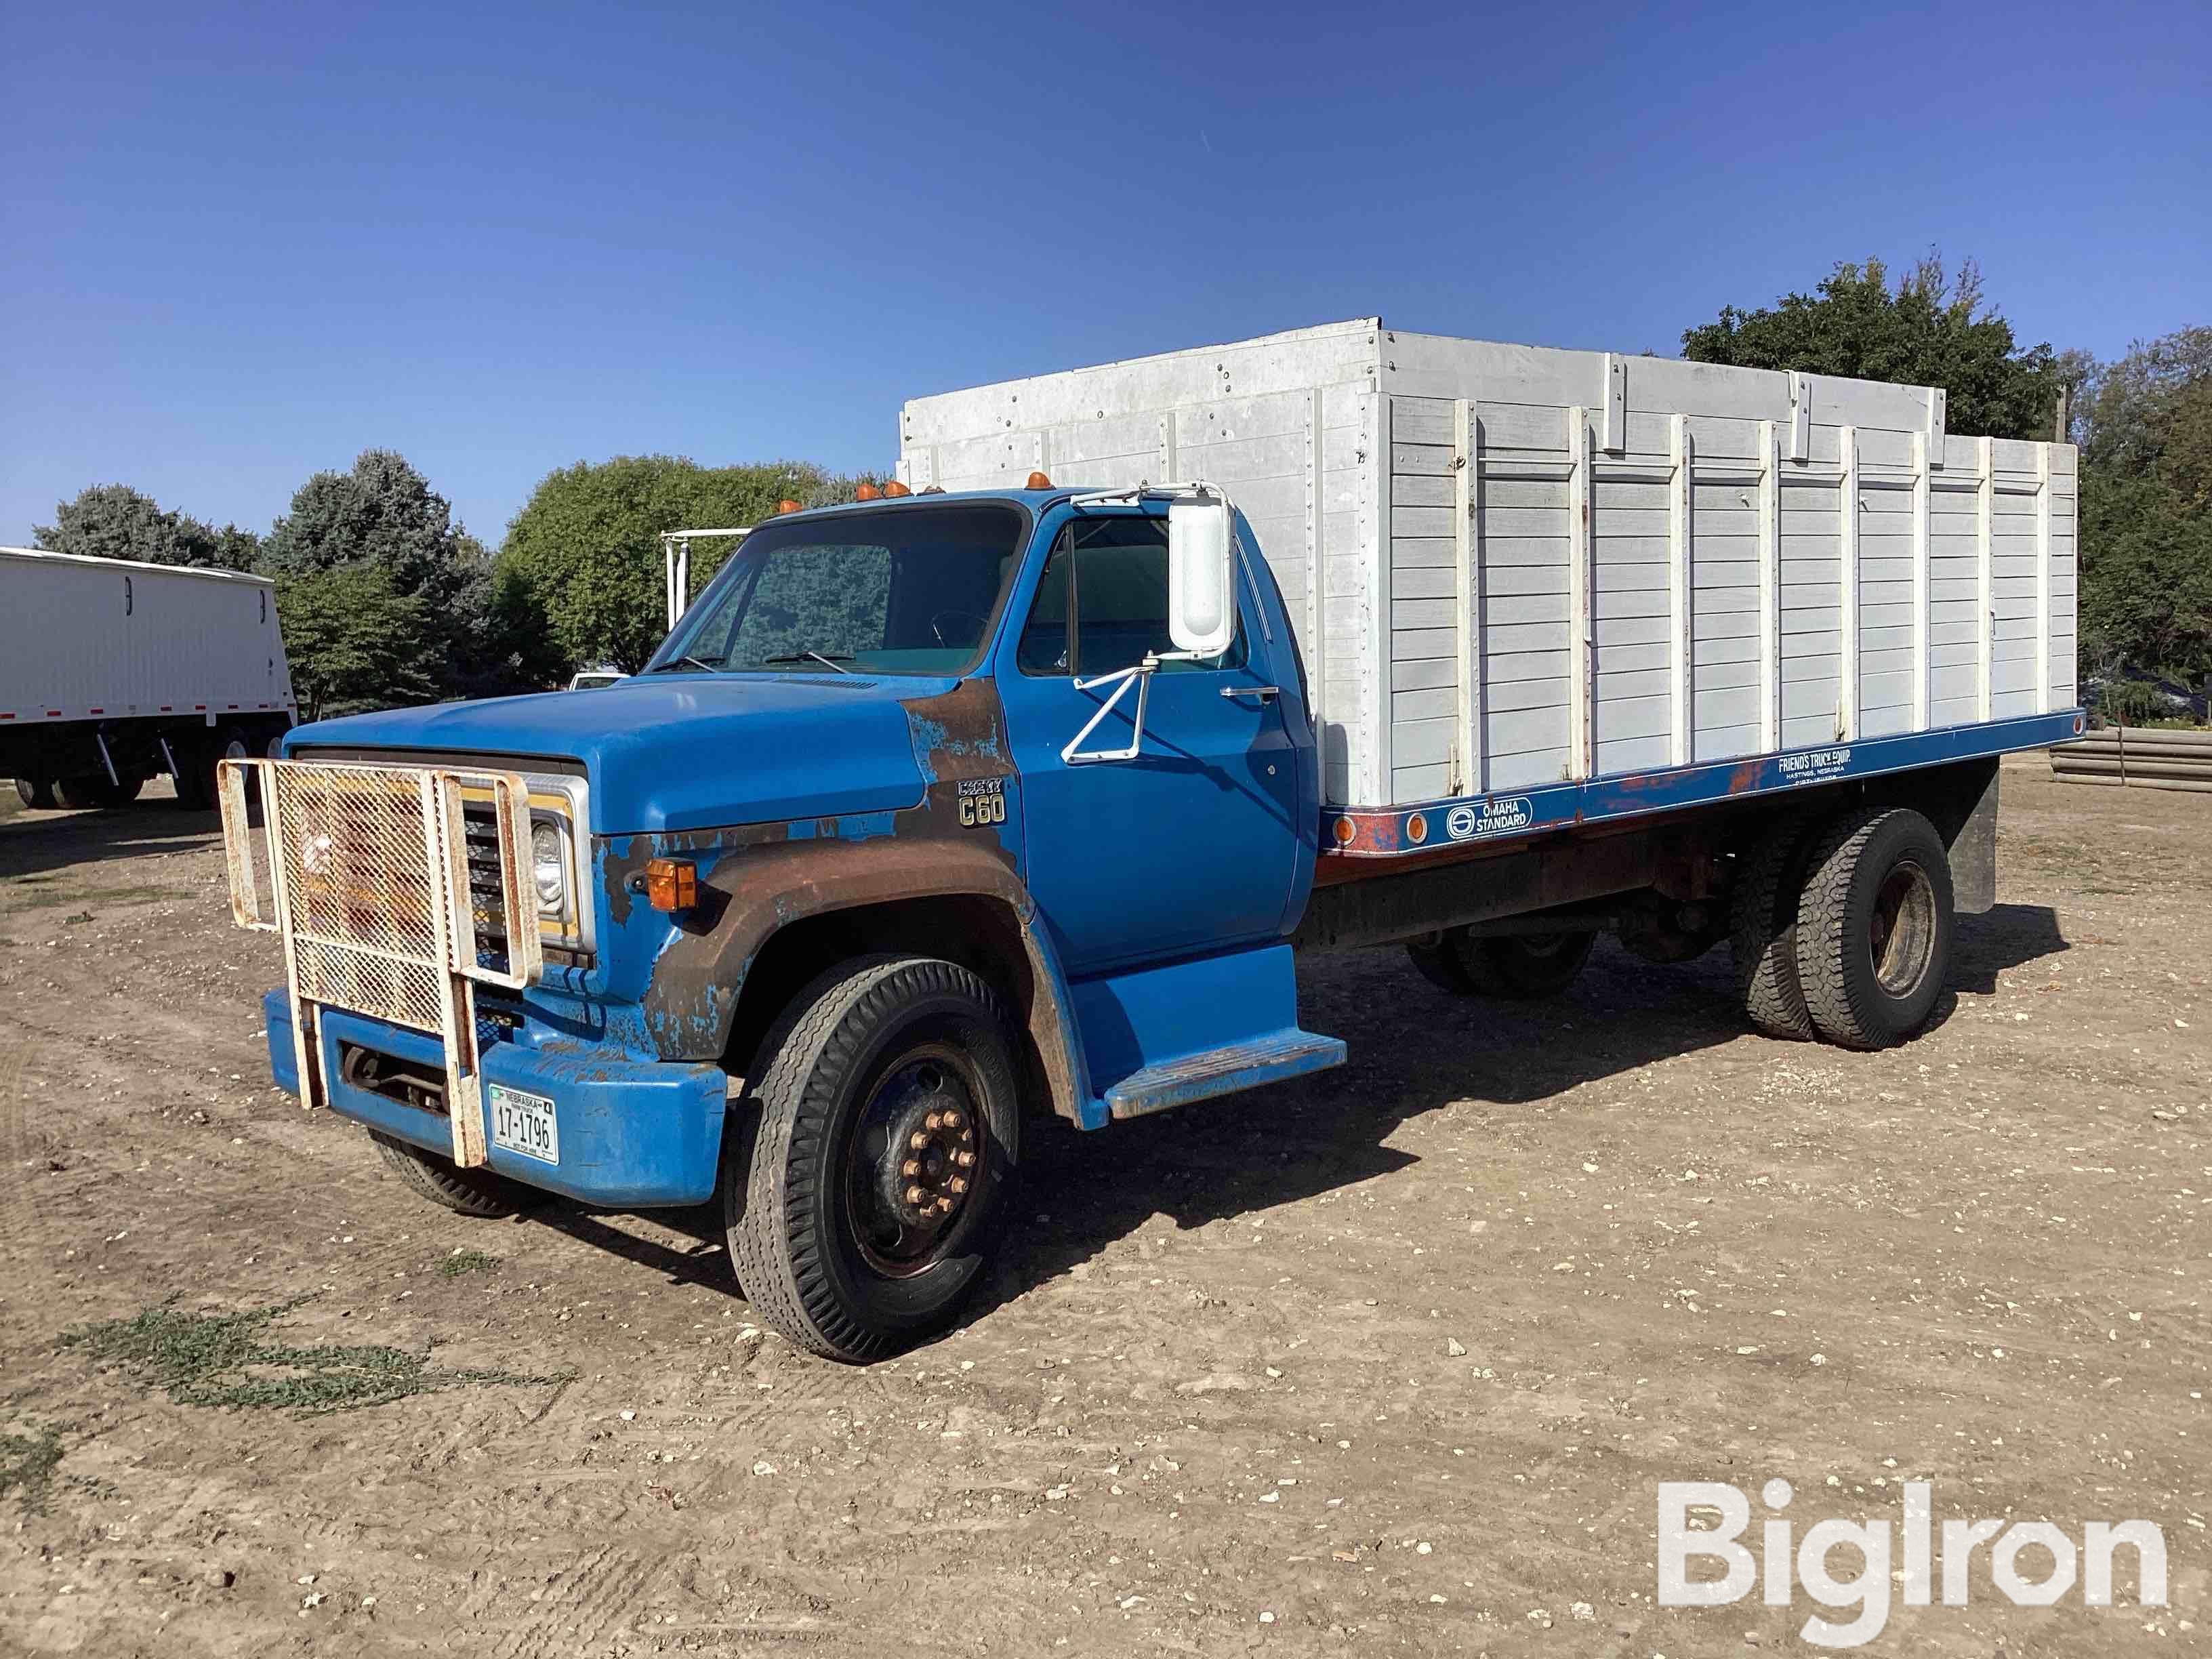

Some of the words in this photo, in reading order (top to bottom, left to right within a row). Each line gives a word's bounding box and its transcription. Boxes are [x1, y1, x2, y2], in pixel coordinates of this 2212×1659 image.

[1778, 754, 1809, 773] FRIEND'S
[1810, 752, 1831, 768] TRUCK
[1832, 749, 1851, 766] EQUIP.
[960, 794, 1004, 825] C60
[1483, 801, 1519, 817] OMAHA
[1477, 813, 1526, 832] STANDARD
[506, 1092, 537, 1107] NEBRASKA
[499, 1105, 549, 1149] 17-1796
